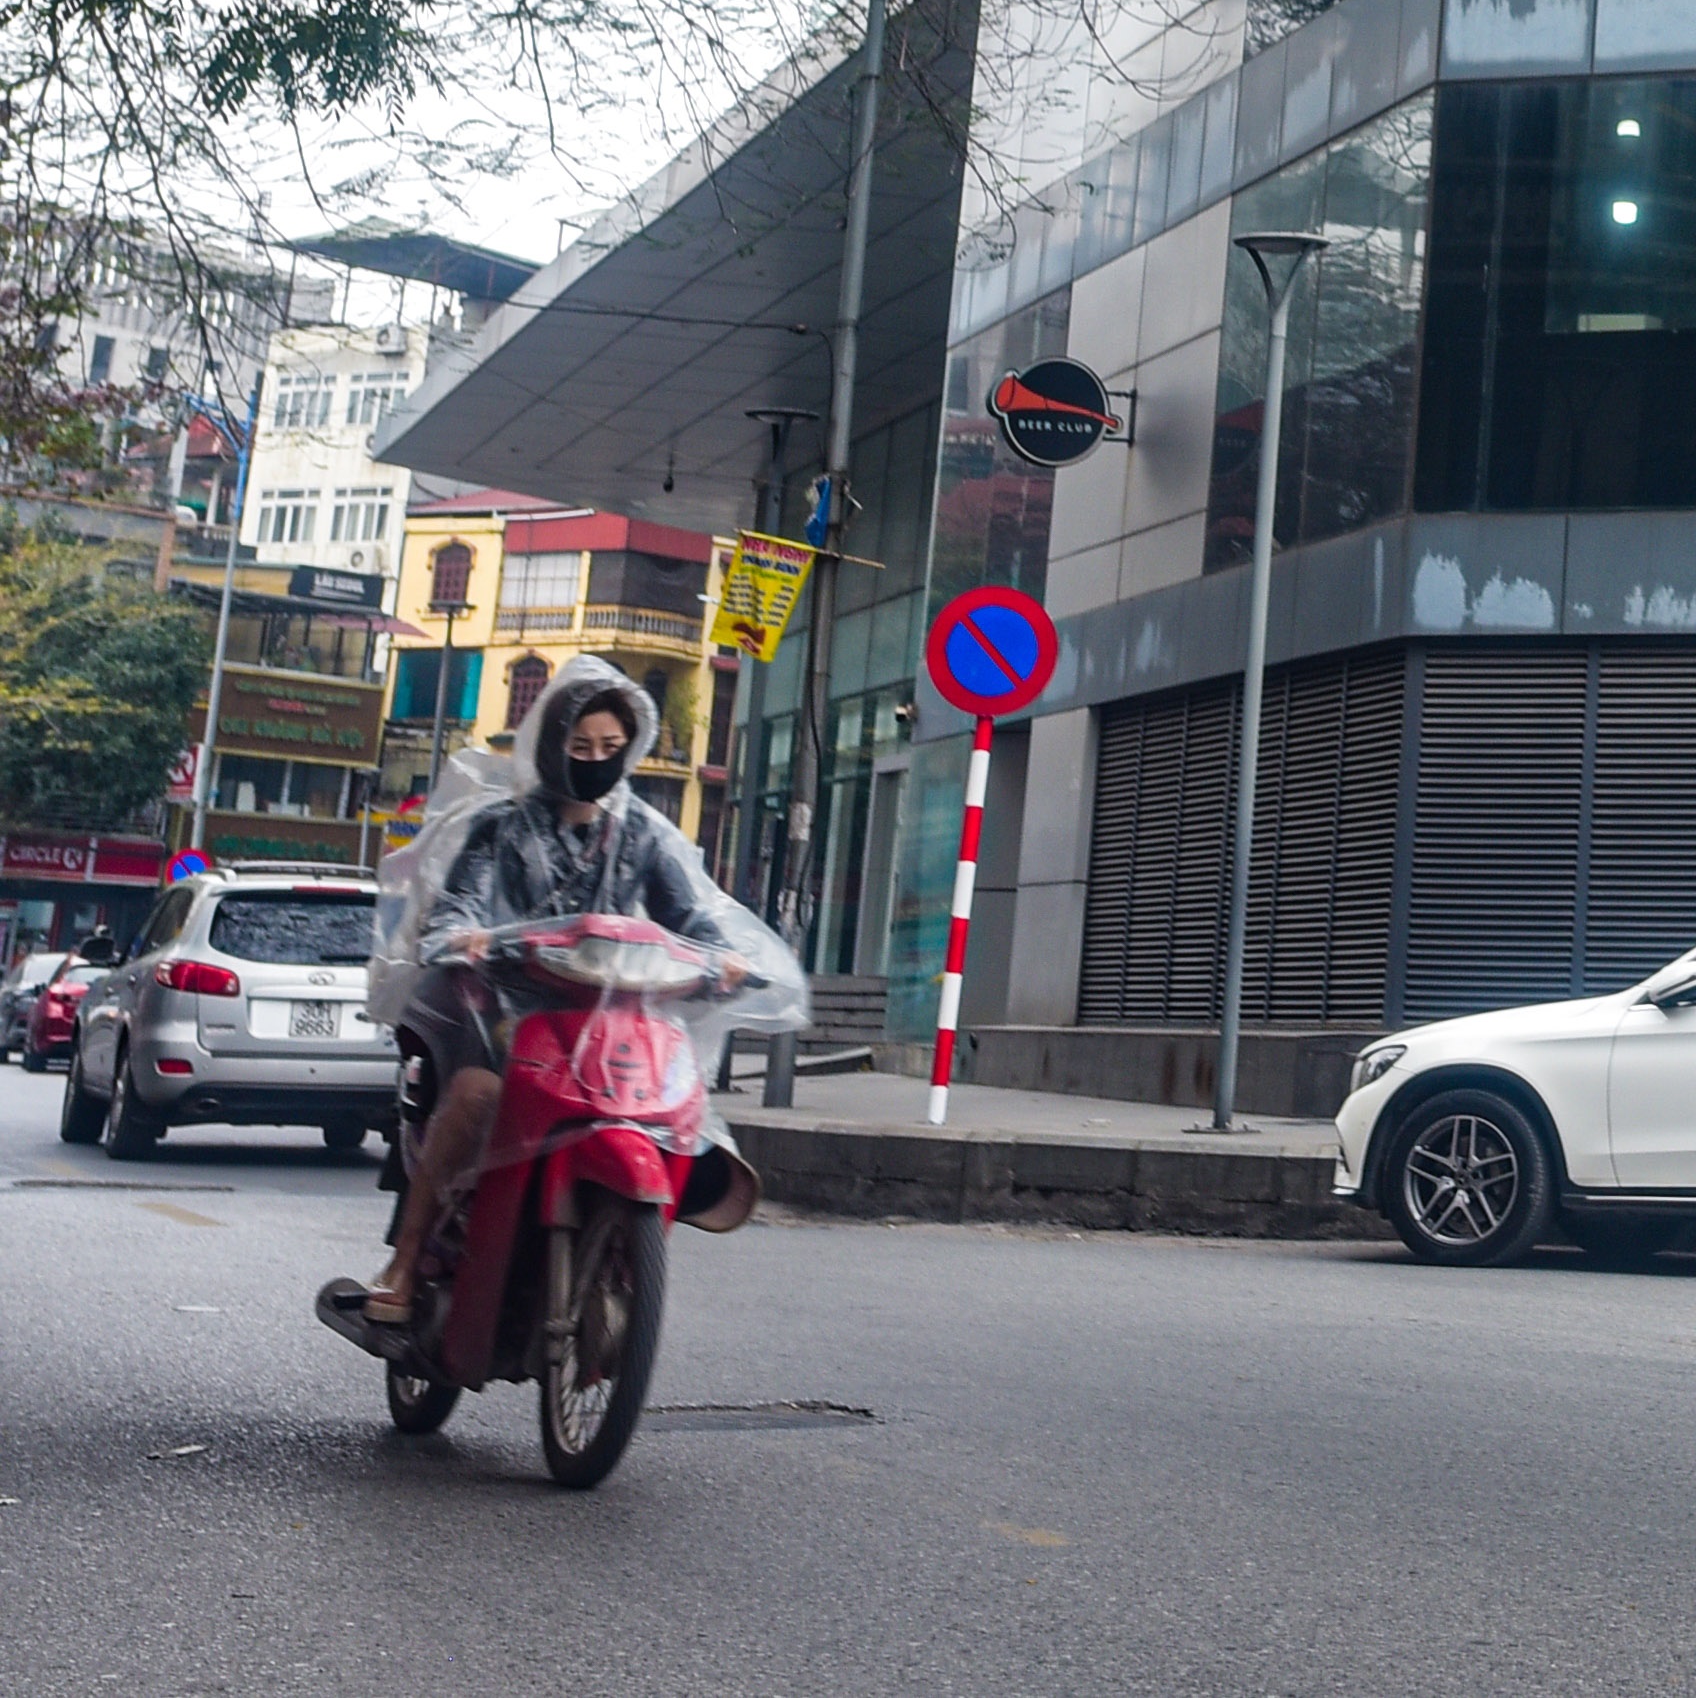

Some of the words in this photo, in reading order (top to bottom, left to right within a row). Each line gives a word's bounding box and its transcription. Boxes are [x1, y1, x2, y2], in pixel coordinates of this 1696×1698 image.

[1018, 419, 1052, 431] BEER
[1057, 422, 1093, 434] CLUB
[10, 846, 61, 864] CIRCLE
